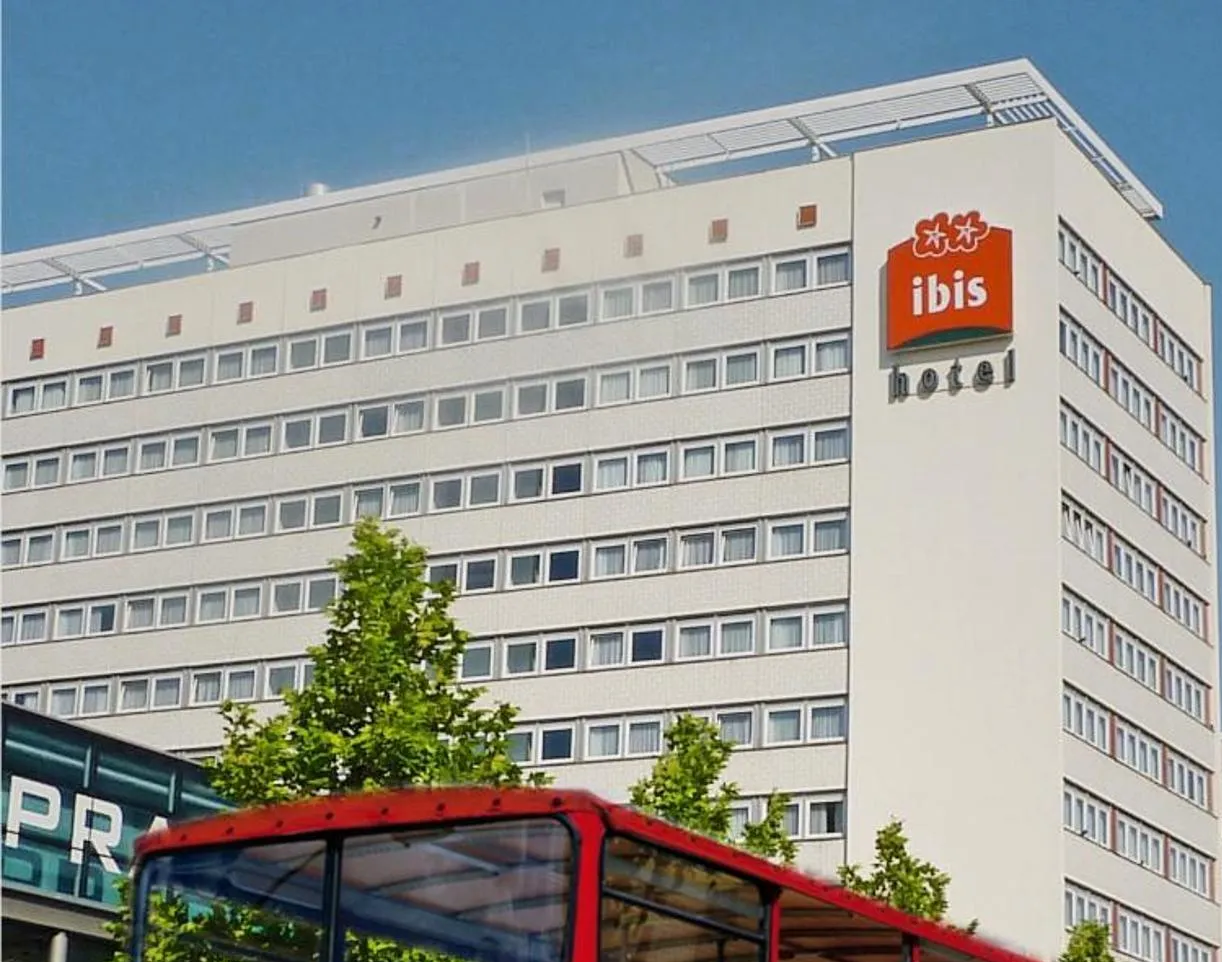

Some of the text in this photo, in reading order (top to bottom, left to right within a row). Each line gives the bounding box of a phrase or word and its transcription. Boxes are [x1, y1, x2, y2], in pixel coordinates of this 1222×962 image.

[911, 269, 988, 316] ibis
[888, 349, 1016, 402] hotel
[5, 774, 168, 876] PR
